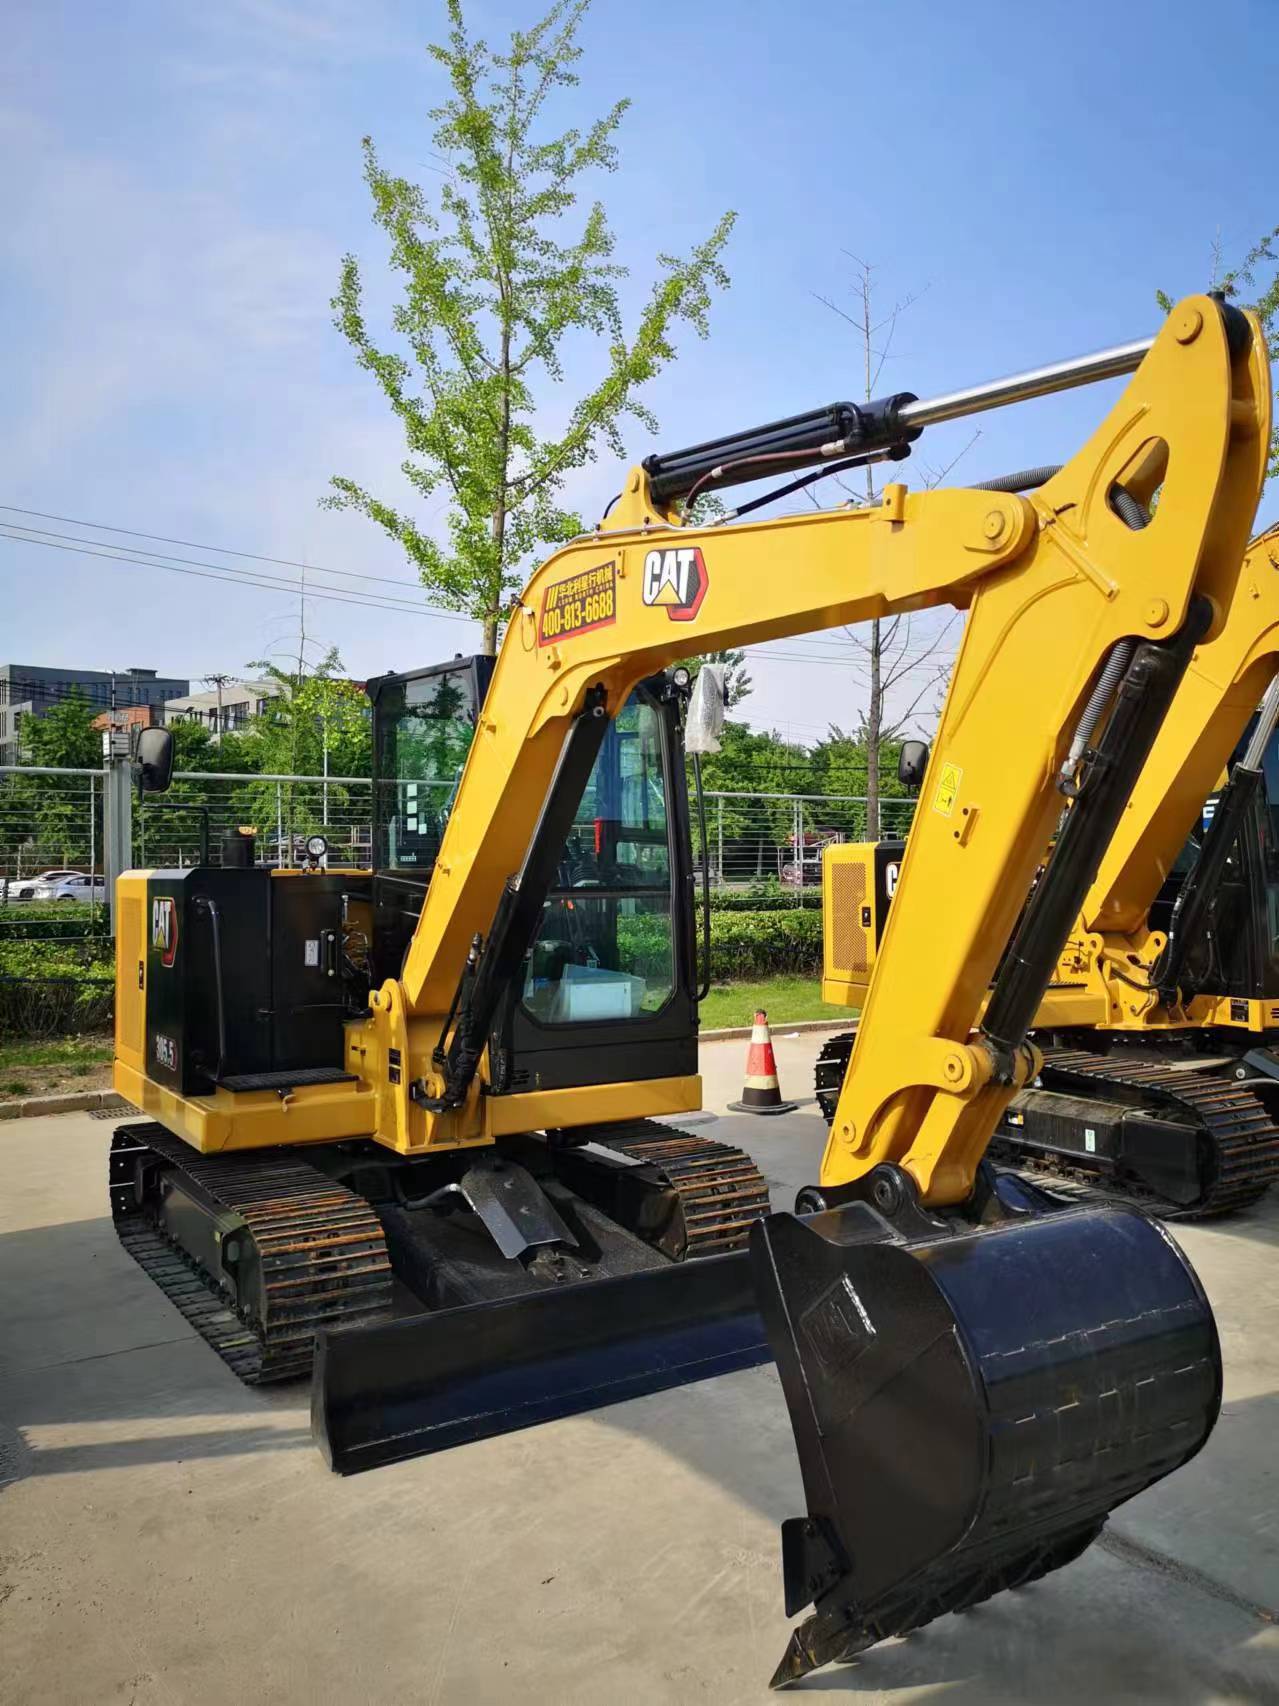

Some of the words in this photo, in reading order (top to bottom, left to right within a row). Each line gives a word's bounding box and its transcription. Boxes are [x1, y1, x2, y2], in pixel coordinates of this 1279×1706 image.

[645, 549, 695, 605] CAT
[542, 590, 613, 637] 400-813-6688
[152, 899, 172, 949] CAT
